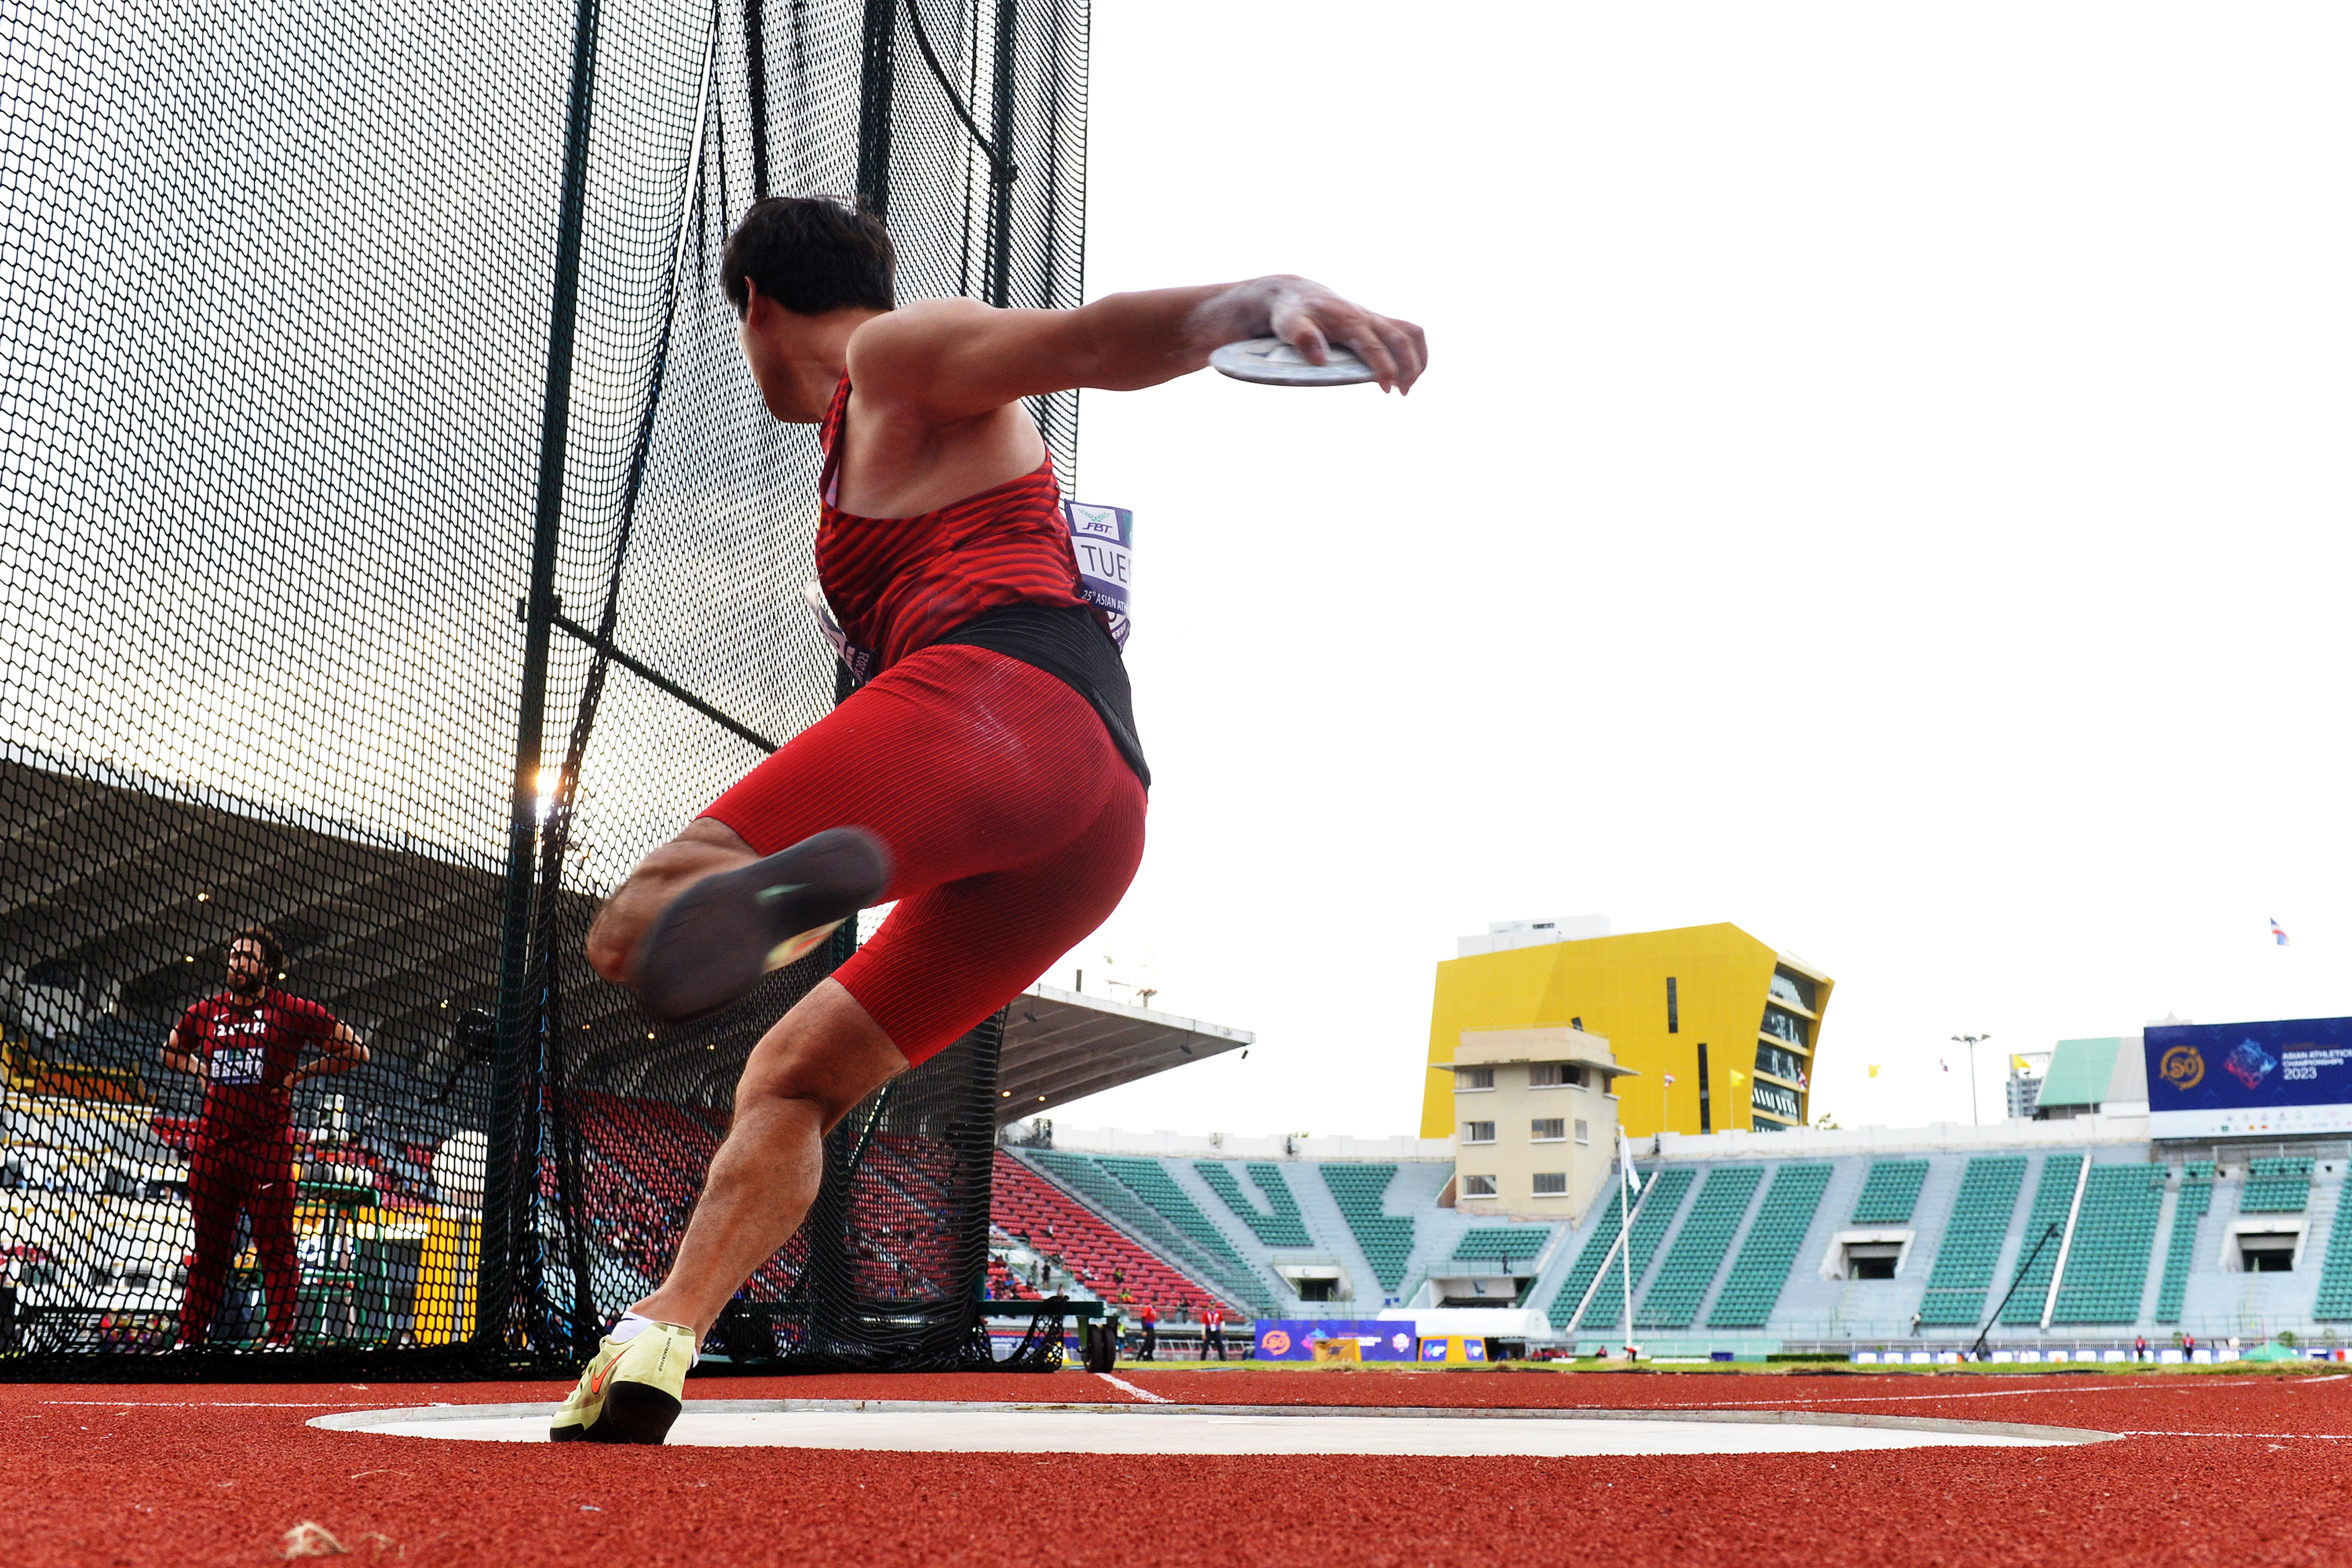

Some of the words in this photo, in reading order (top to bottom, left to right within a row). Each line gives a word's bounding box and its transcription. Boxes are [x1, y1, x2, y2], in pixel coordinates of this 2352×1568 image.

[1082, 522, 1113, 533] FBT
[1095, 593, 1116, 609] ASIAN
[855, 652, 870, 671] 2023
[2282, 1051, 2308, 1060] ASIAN
[2283, 1066, 2318, 1080] 2023
